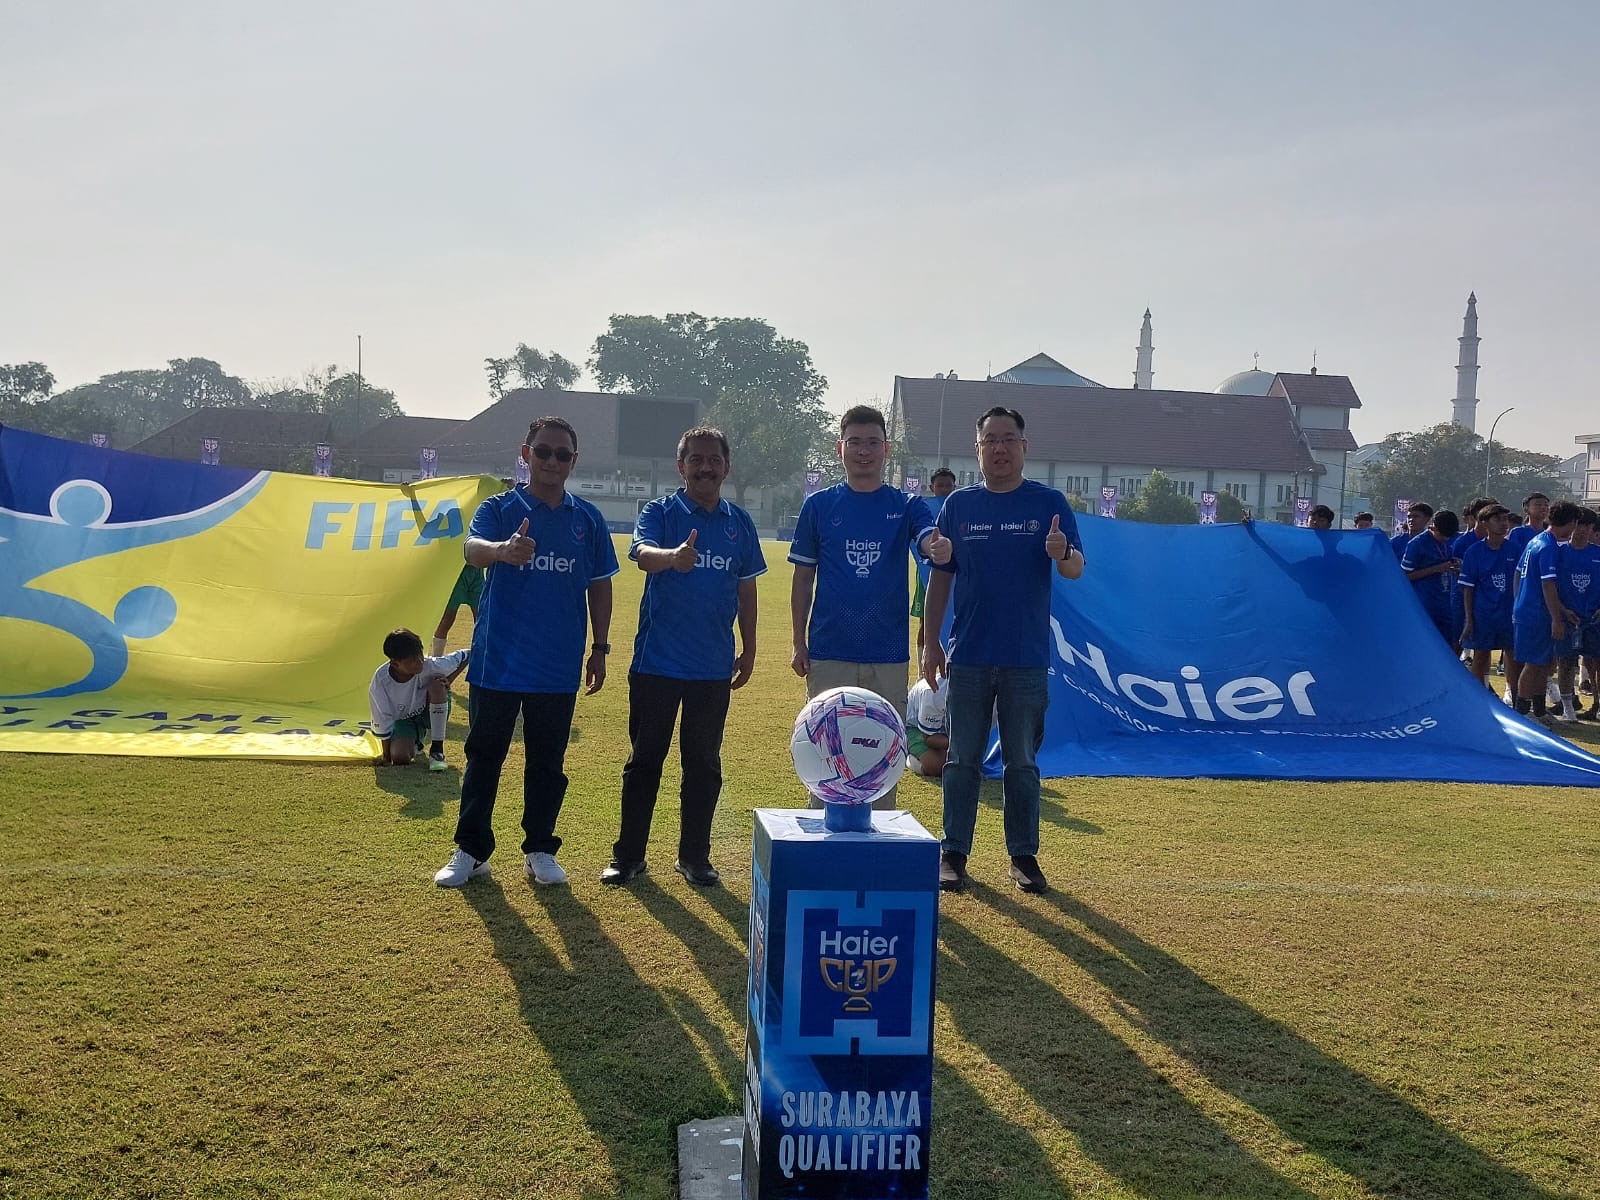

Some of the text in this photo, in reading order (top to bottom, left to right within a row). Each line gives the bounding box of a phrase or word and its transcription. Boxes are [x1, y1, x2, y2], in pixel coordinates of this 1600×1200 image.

[305, 499, 464, 551] FIFA
[970, 523, 993, 532] Haier
[1000, 522, 1024, 531] Haier
[845, 539, 881, 551] Haier
[694, 549, 733, 571] aier
[846, 551, 881, 567] CUP
[1050, 614, 1316, 721] Haier
[72, 709, 292, 725] GAME
[819, 930, 898, 956] Haier
[819, 957, 898, 993] CUP
[780, 1090, 921, 1128] SURABAYA
[778, 1134, 921, 1178] QUALIFIER
